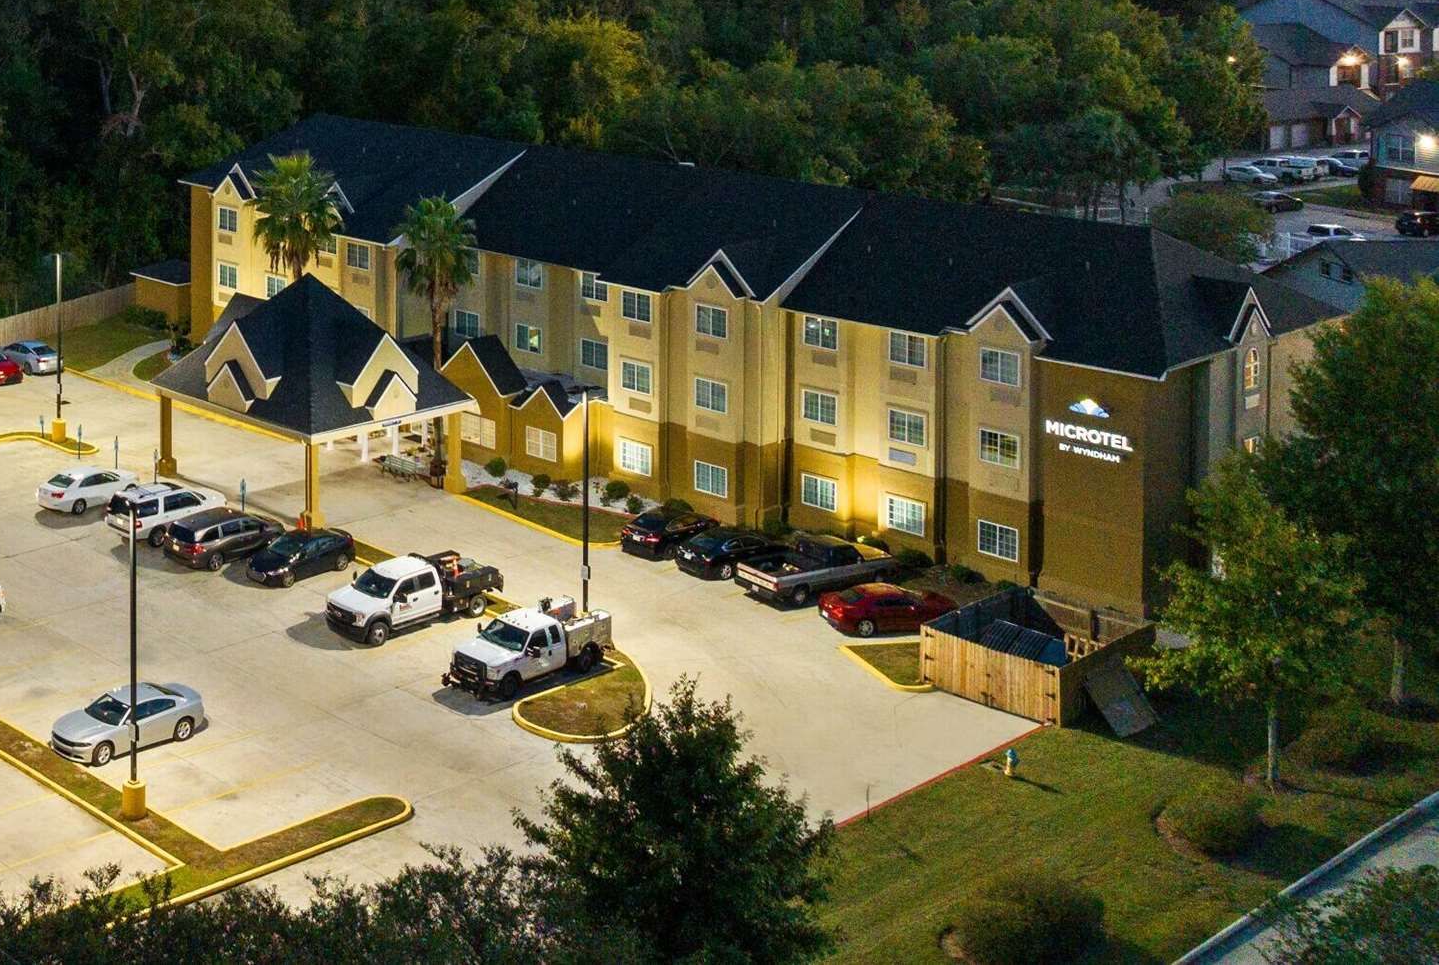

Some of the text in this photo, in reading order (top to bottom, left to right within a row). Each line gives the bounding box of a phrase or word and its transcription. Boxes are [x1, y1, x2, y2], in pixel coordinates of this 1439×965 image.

[1045, 419, 1134, 452] MICROTEL
[1059, 443, 1120, 463] BY WYNDHAM
